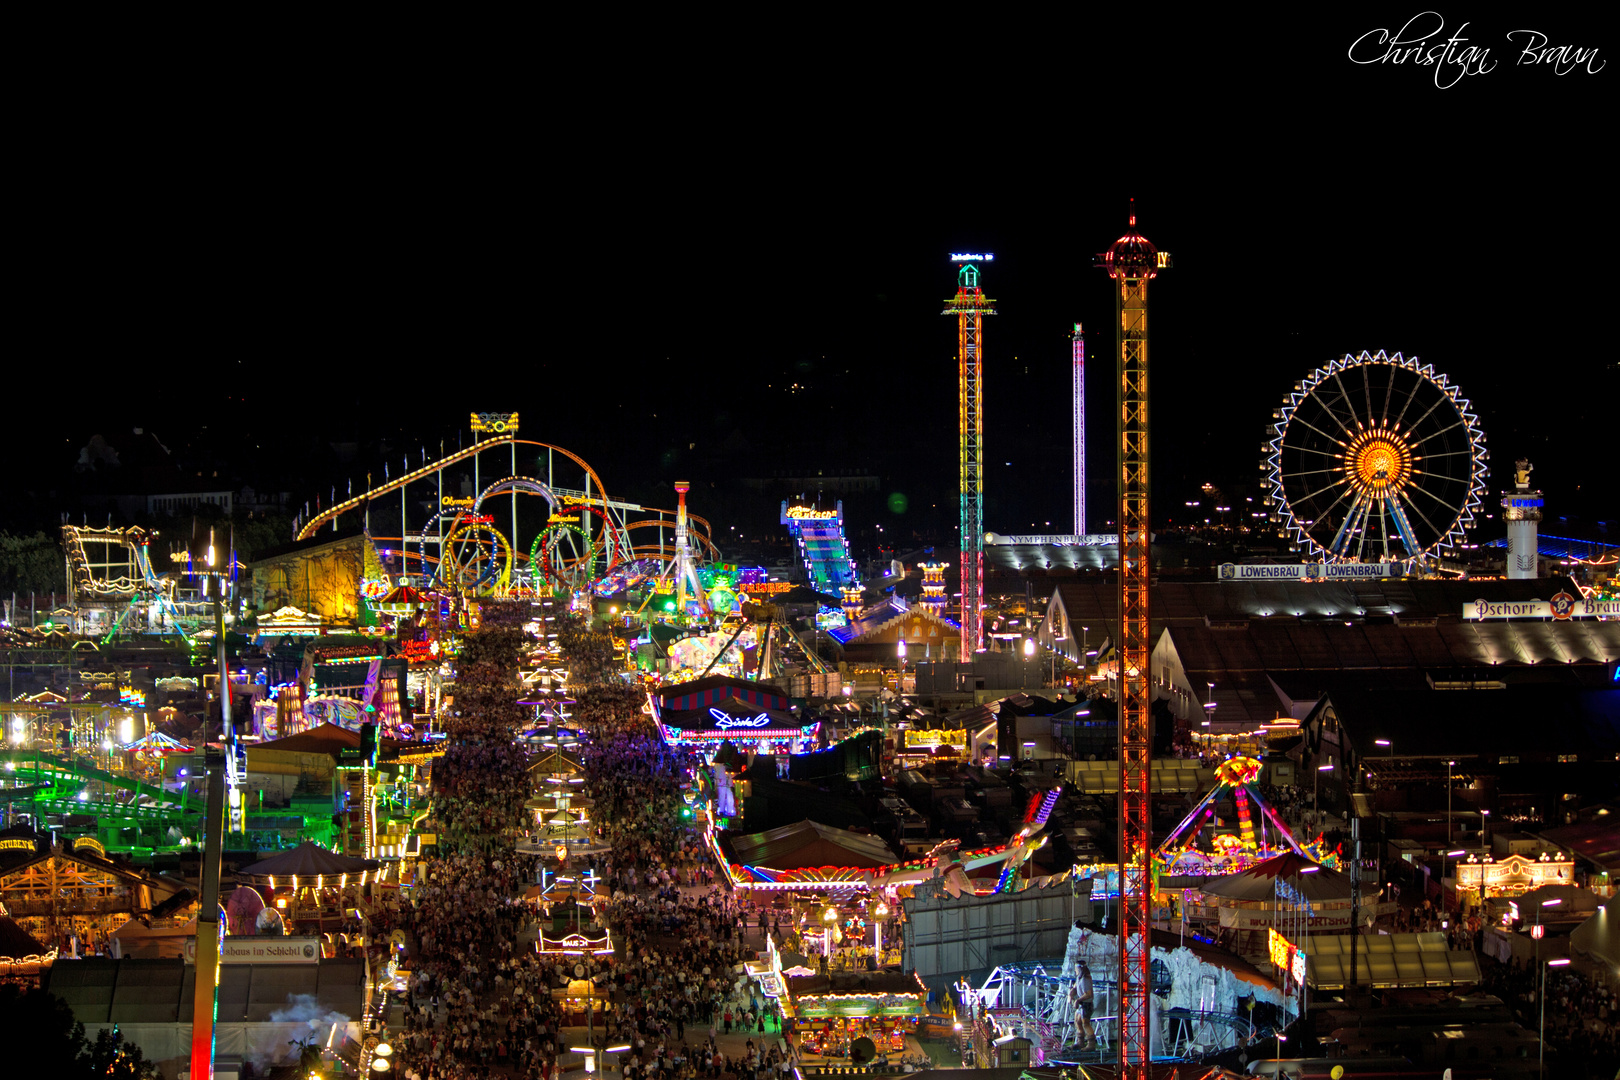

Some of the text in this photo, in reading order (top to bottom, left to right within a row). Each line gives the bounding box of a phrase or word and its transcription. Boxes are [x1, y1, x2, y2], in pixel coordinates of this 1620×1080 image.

[442, 496, 474, 506] Olympia
[547, 514, 579, 522] München
[1009, 535, 1093, 544] NYMPHENBURG
[1241, 565, 1383, 577] LÖWENBRÄU LÖWENBRÄU
[739, 582, 791, 593] FRISBEE
[1475, 600, 1541, 620] Pschorr-
[253, 947, 264, 956] im
[266, 946, 300, 956] Schichtl
